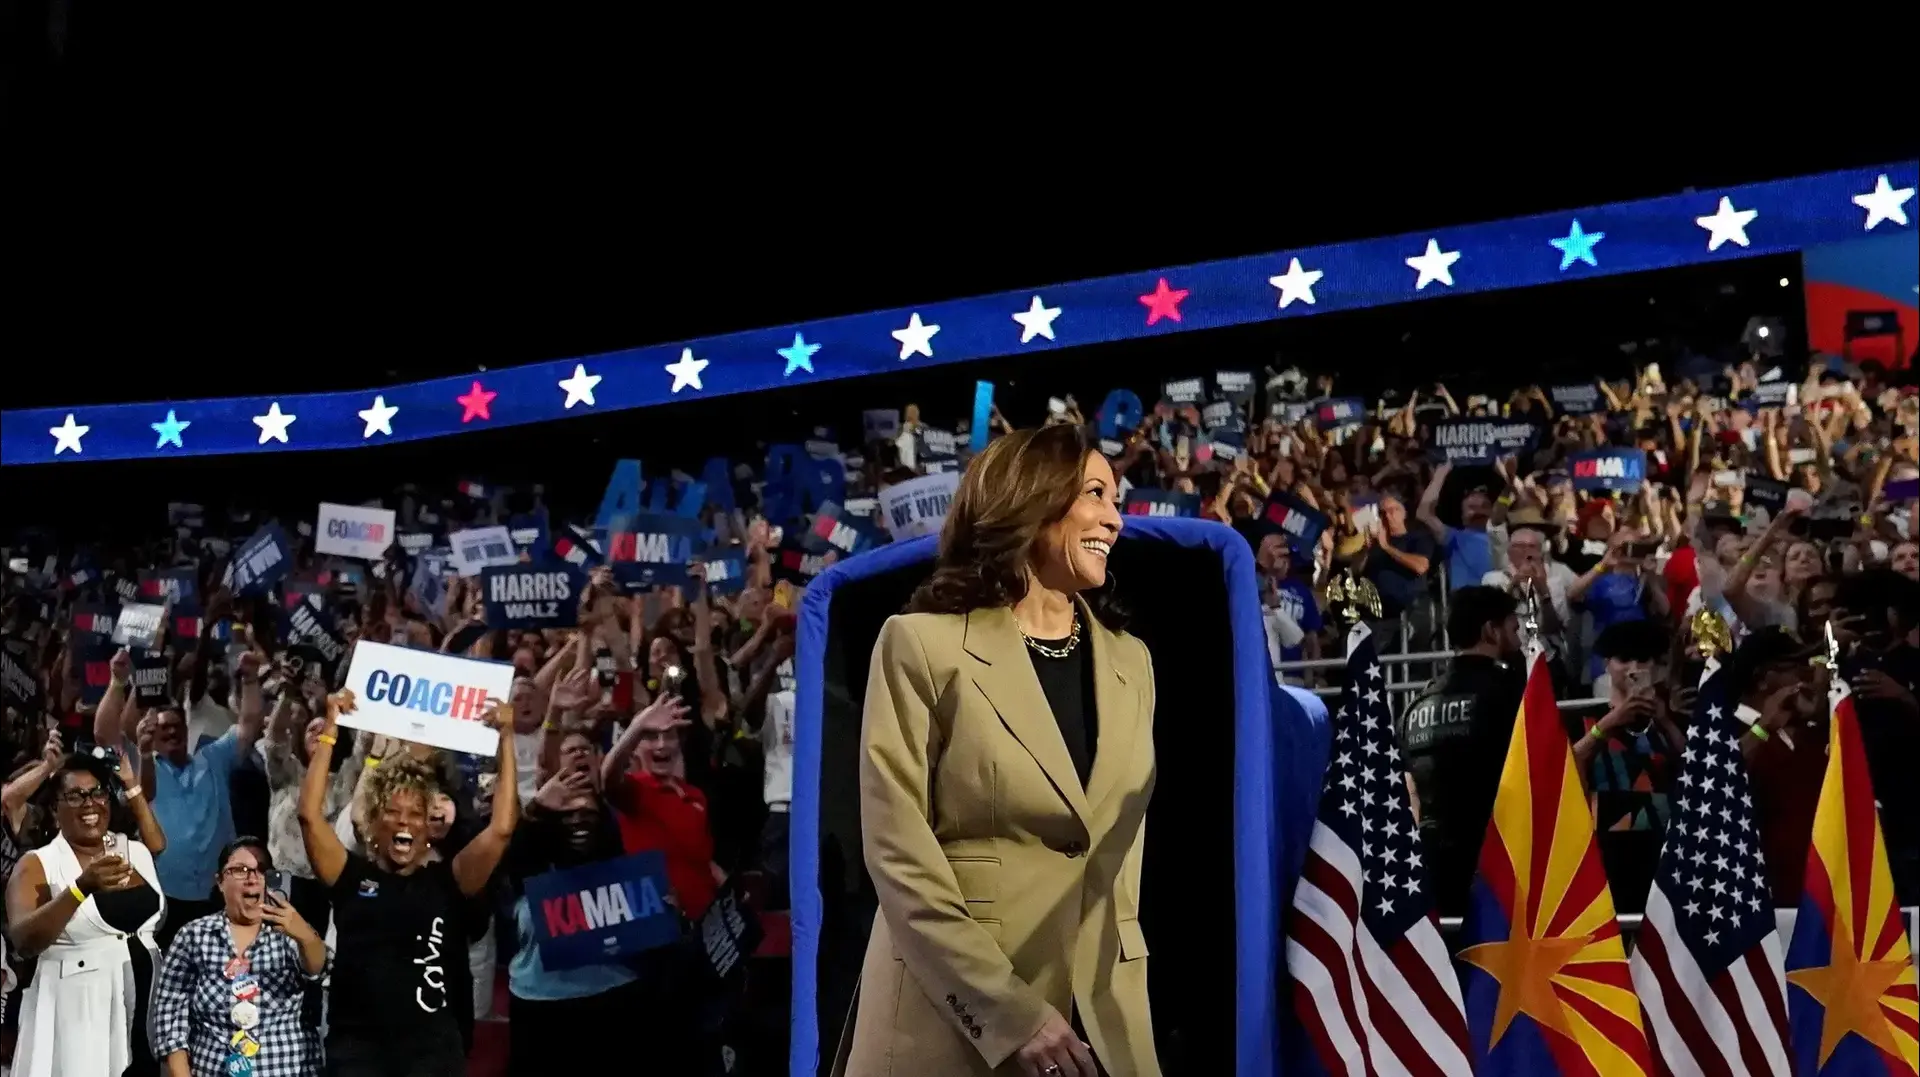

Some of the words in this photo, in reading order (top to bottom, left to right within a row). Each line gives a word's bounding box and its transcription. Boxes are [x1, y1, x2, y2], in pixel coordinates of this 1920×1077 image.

[1435, 422, 1496, 447] HARRIS
[1445, 446, 1487, 459] WALZ
[490, 572, 571, 602] HARRIS
[504, 602, 559, 619] WALZ
[366, 669, 488, 721] COACH!
[1408, 699, 1472, 731] POLICE
[542, 875, 666, 938] KAMALA
[413, 916, 447, 1013] Calvin
